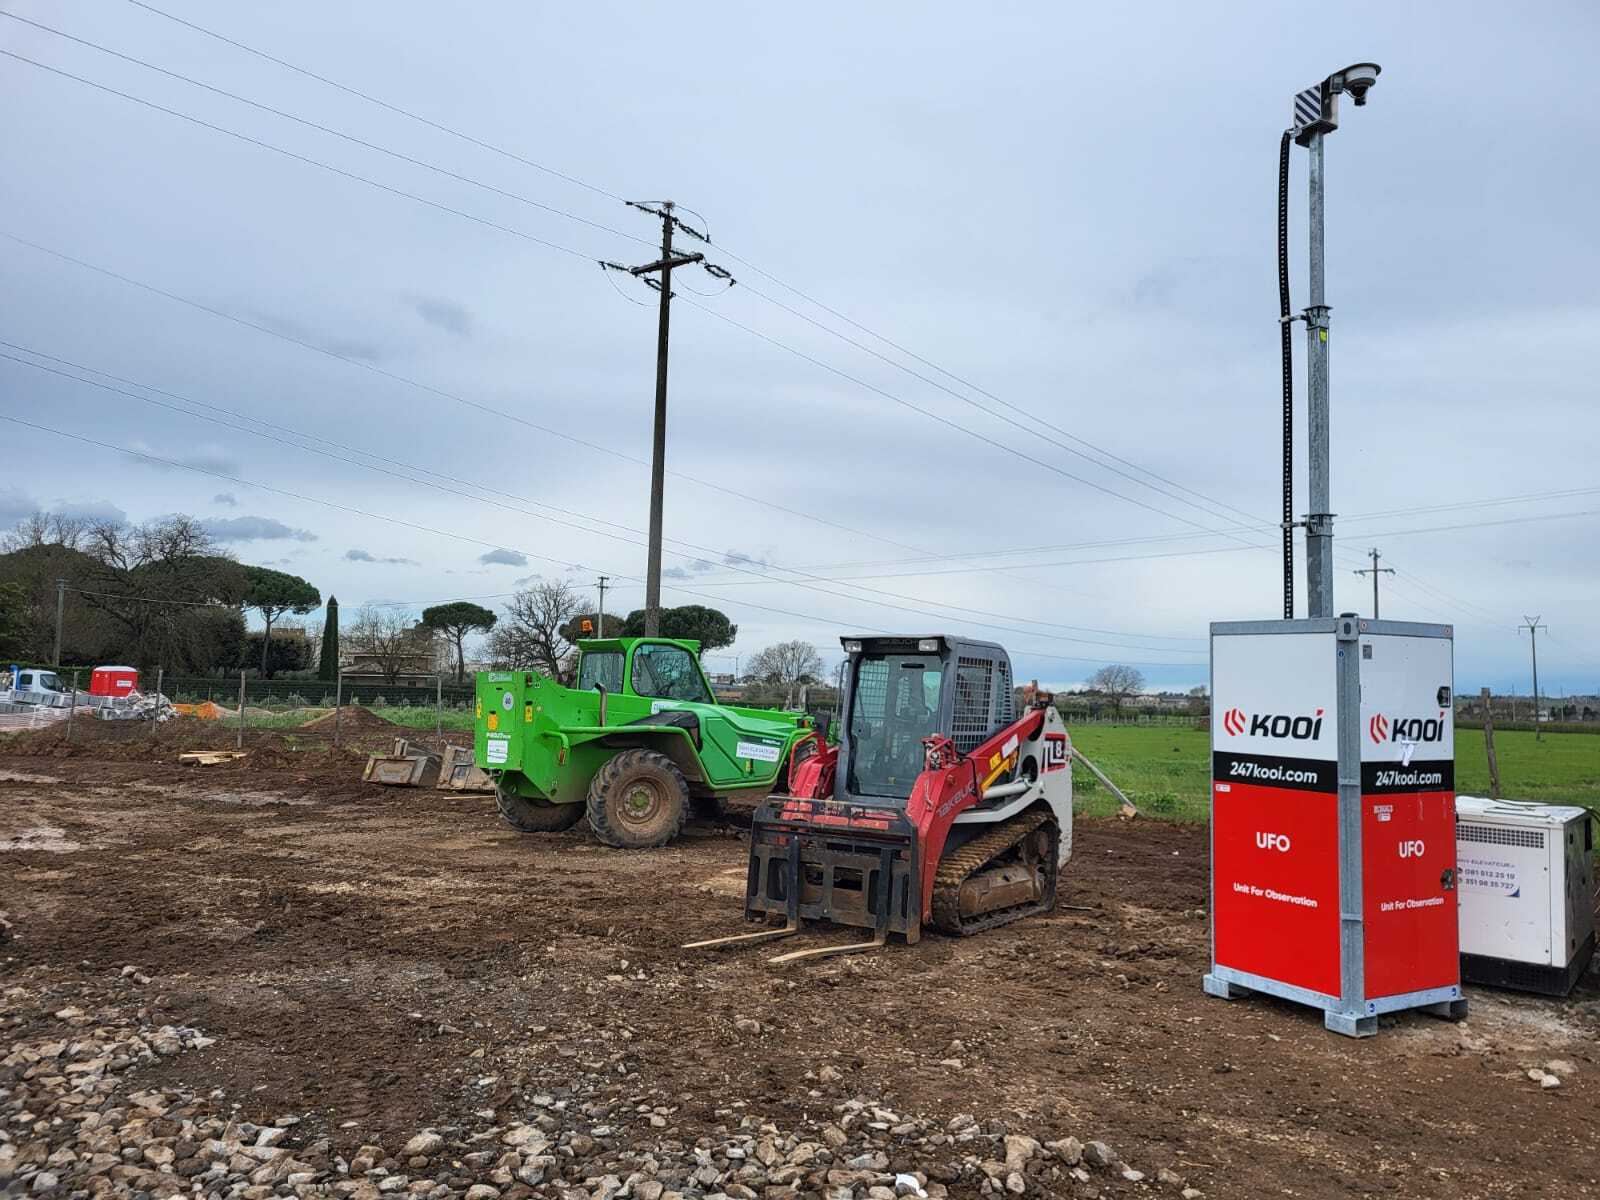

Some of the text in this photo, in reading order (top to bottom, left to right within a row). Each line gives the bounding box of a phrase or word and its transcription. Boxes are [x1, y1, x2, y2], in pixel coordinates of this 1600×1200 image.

[1230, 762, 1318, 784] 247kooi.com
[1375, 771, 1442, 786] 247kooi.com
[1256, 832, 1290, 852] UFO
[1399, 840, 1425, 858] UFO
[1233, 882, 1318, 908] Unit For Observation
[1380, 896, 1445, 912] Unit For Observation
